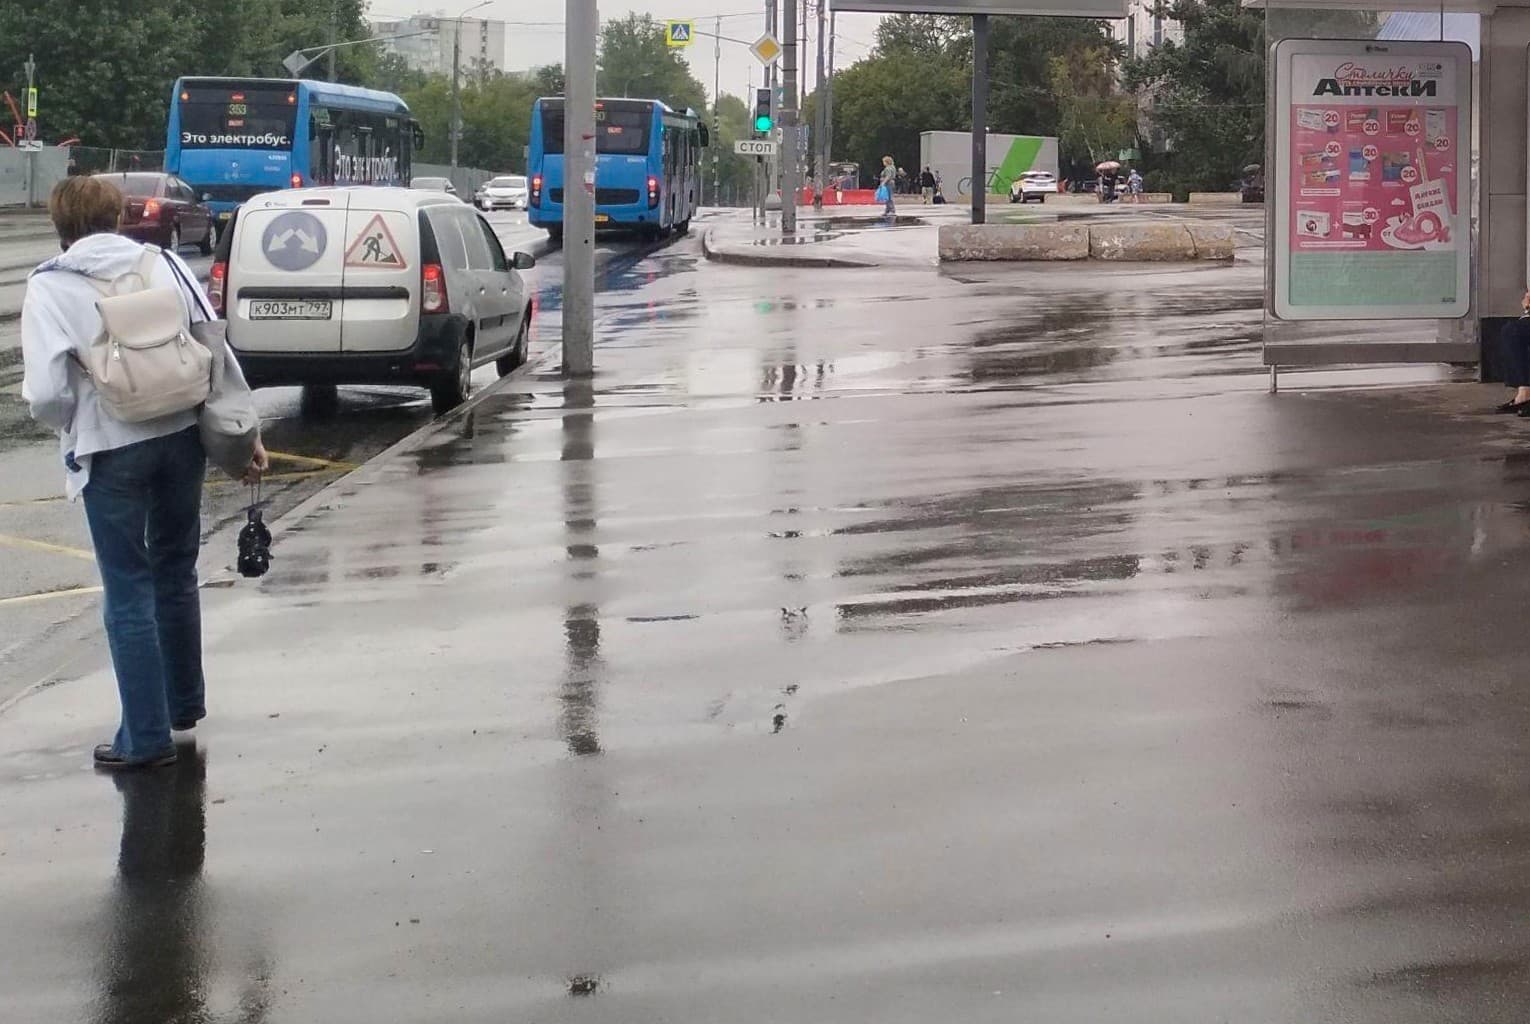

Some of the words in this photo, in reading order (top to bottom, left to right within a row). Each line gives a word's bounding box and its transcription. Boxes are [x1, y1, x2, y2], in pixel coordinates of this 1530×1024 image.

[1325, 114, 1338, 123] 20
[1365, 123, 1379, 132] 20
[1406, 123, 1420, 132] 20
[181, 133, 207, 144] Это
[210, 133, 291, 147] электробус.
[1436, 139, 1449, 148] 20
[739, 142, 773, 154] СТОП
[334, 144, 351, 181] Это
